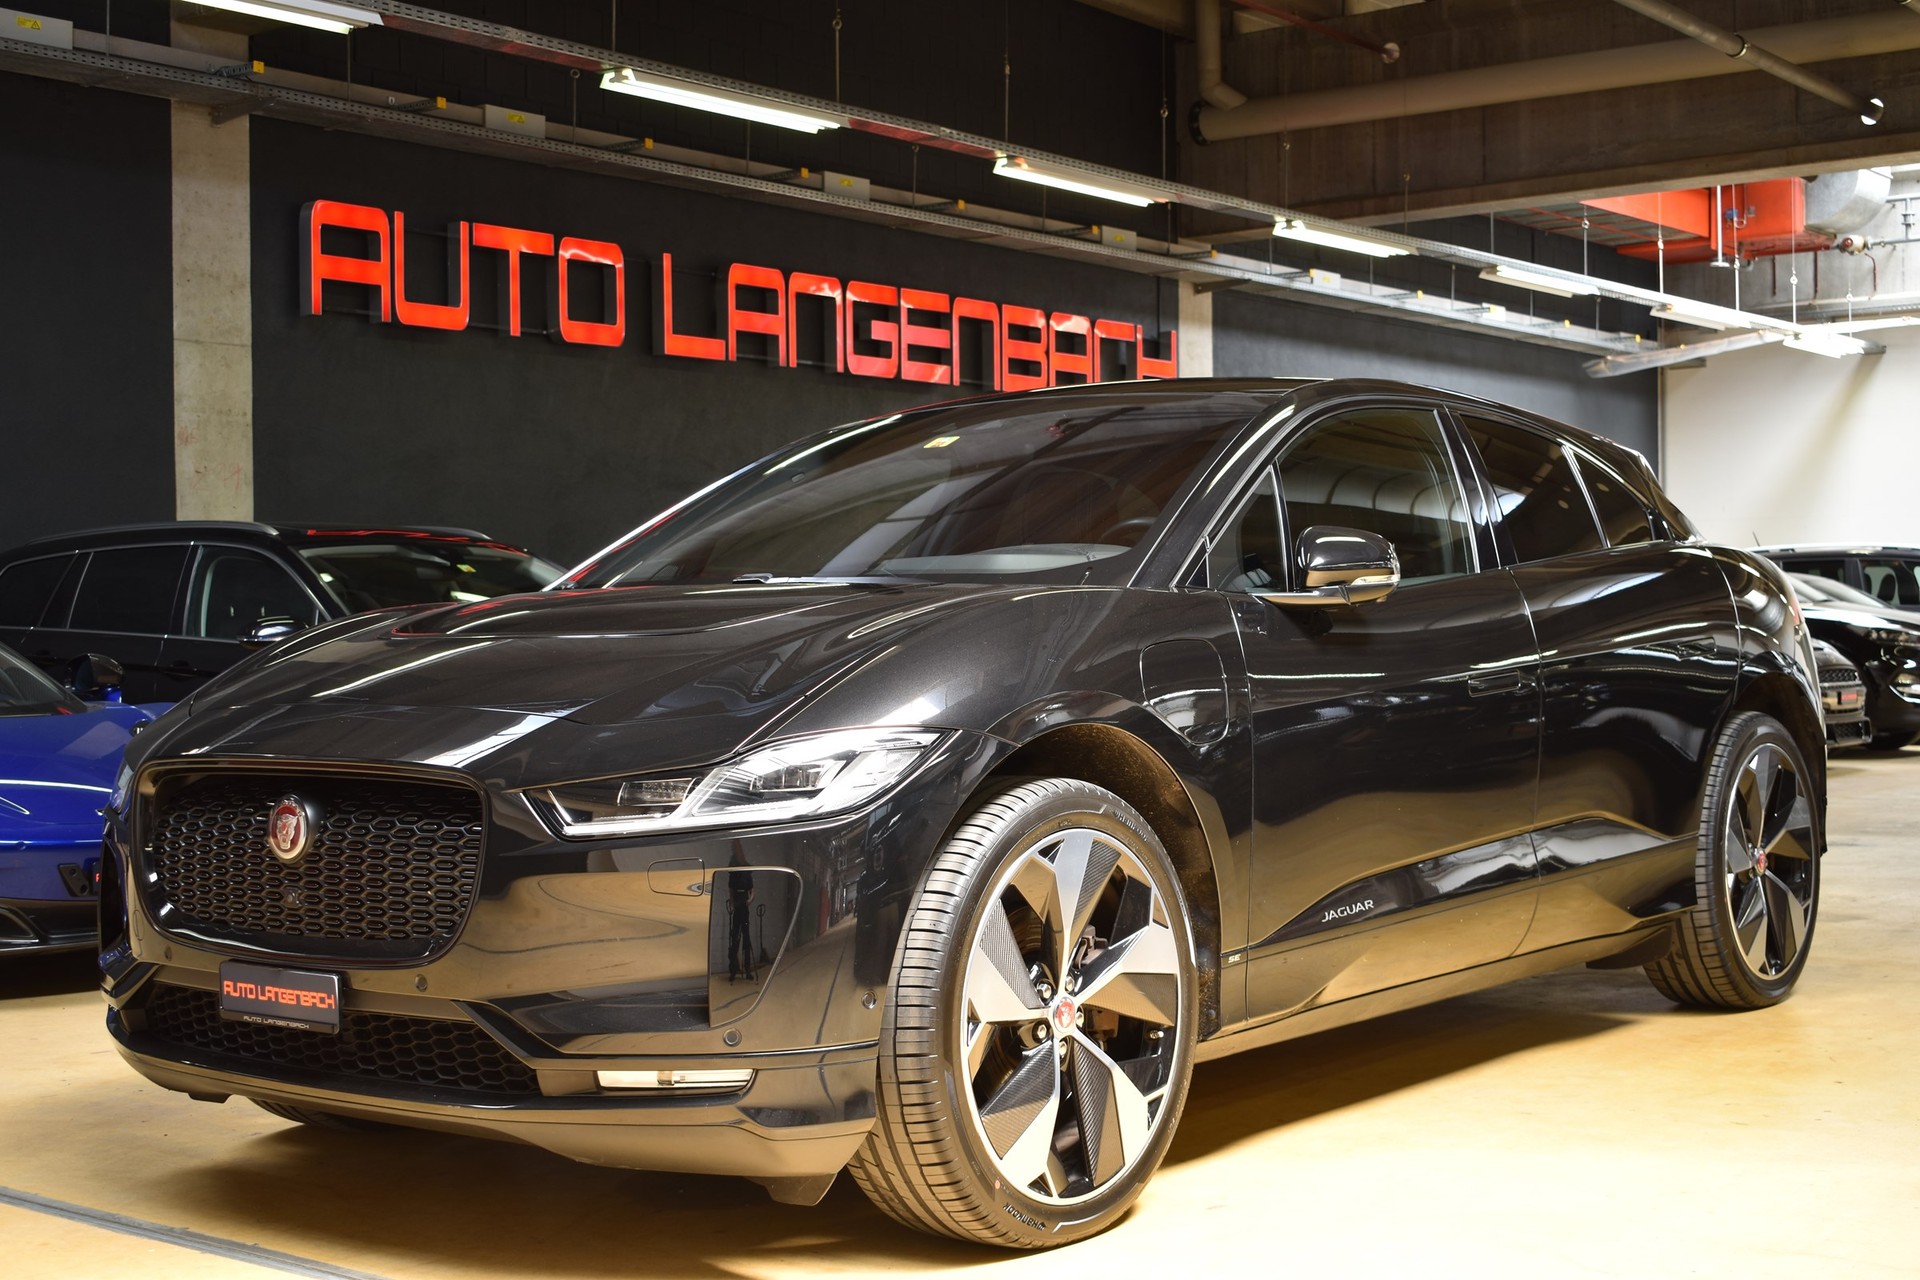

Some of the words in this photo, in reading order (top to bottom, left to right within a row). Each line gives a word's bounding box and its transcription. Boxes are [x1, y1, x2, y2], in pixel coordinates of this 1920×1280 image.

[303, 199, 626, 348] AUTO
[659, 251, 1179, 393] LANGENBACH
[1321, 899, 1375, 923] JAGUAR
[223, 980, 256, 999] AUTO
[258, 985, 336, 1010] LANGENBACH
[243, 1015, 262, 1023] AUTO
